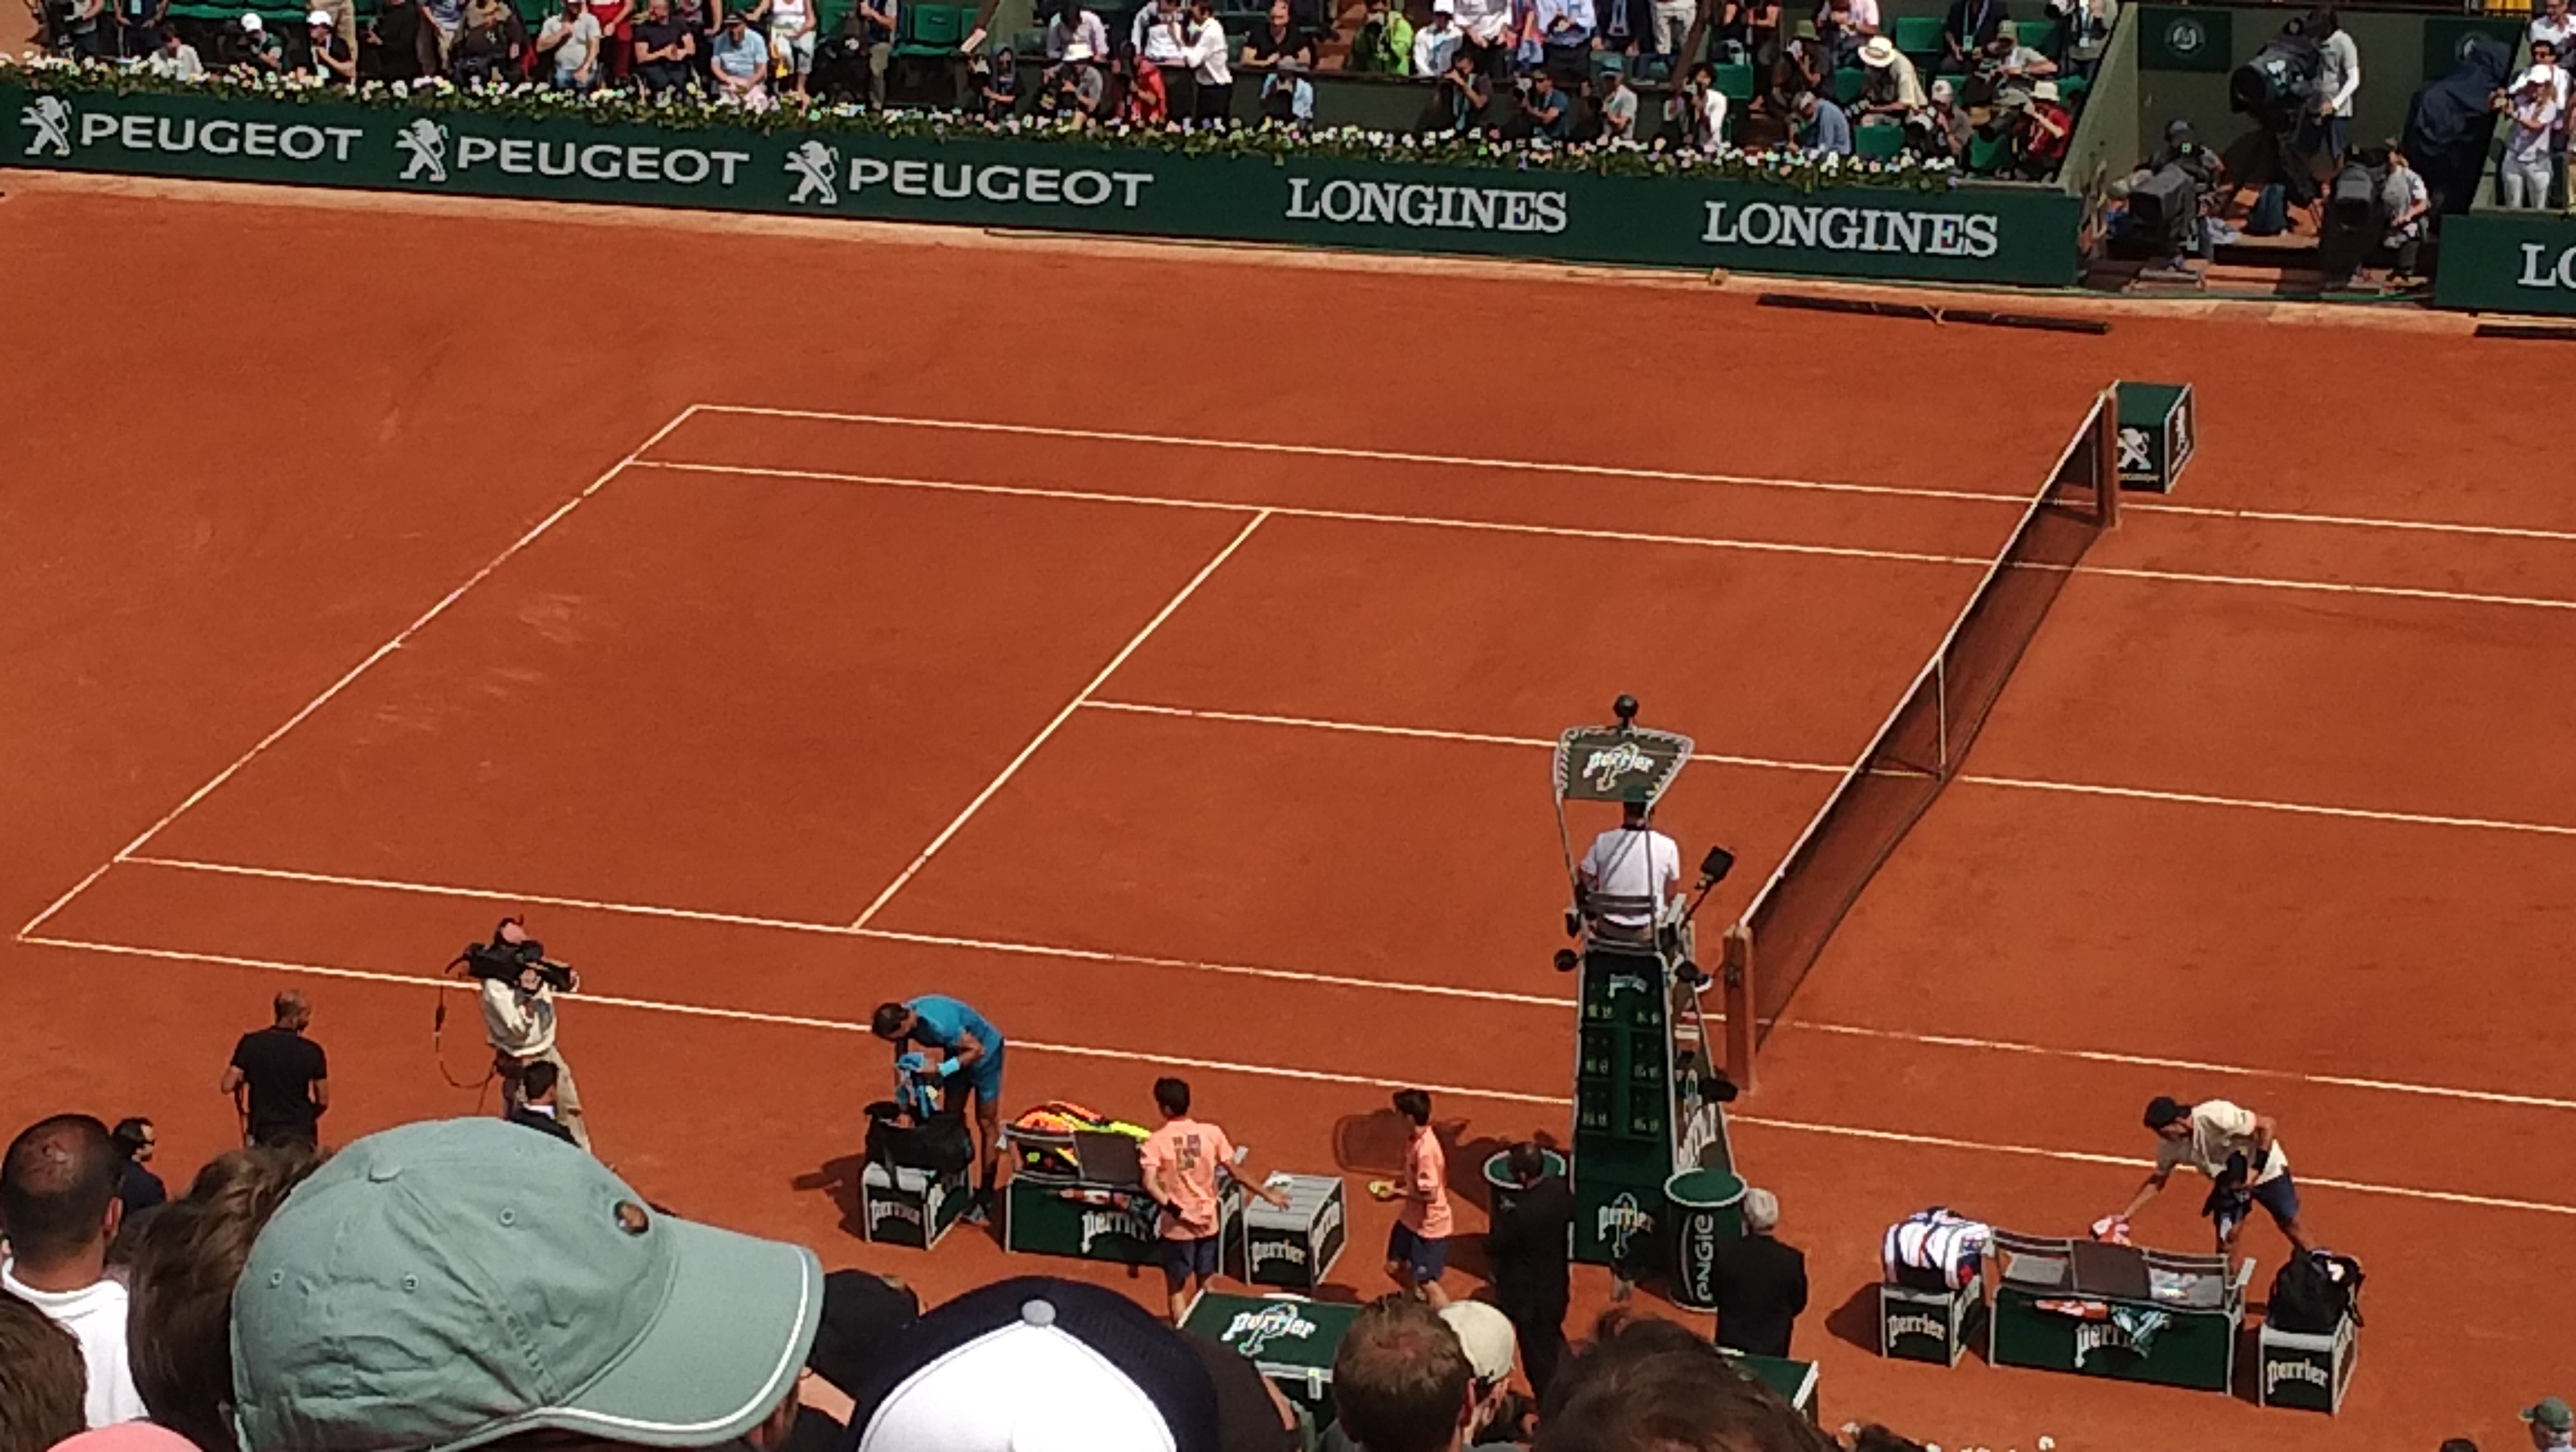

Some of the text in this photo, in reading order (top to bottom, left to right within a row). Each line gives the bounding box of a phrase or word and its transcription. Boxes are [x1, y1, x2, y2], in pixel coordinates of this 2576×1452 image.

[81, 112, 363, 161] PEUGEOT
[457, 137, 749, 184] PEUGEOT
[848, 158, 1154, 207] PEUGEOT
[1285, 178, 1567, 234] LONGINES
[1702, 201, 1998, 258] LONGINES
